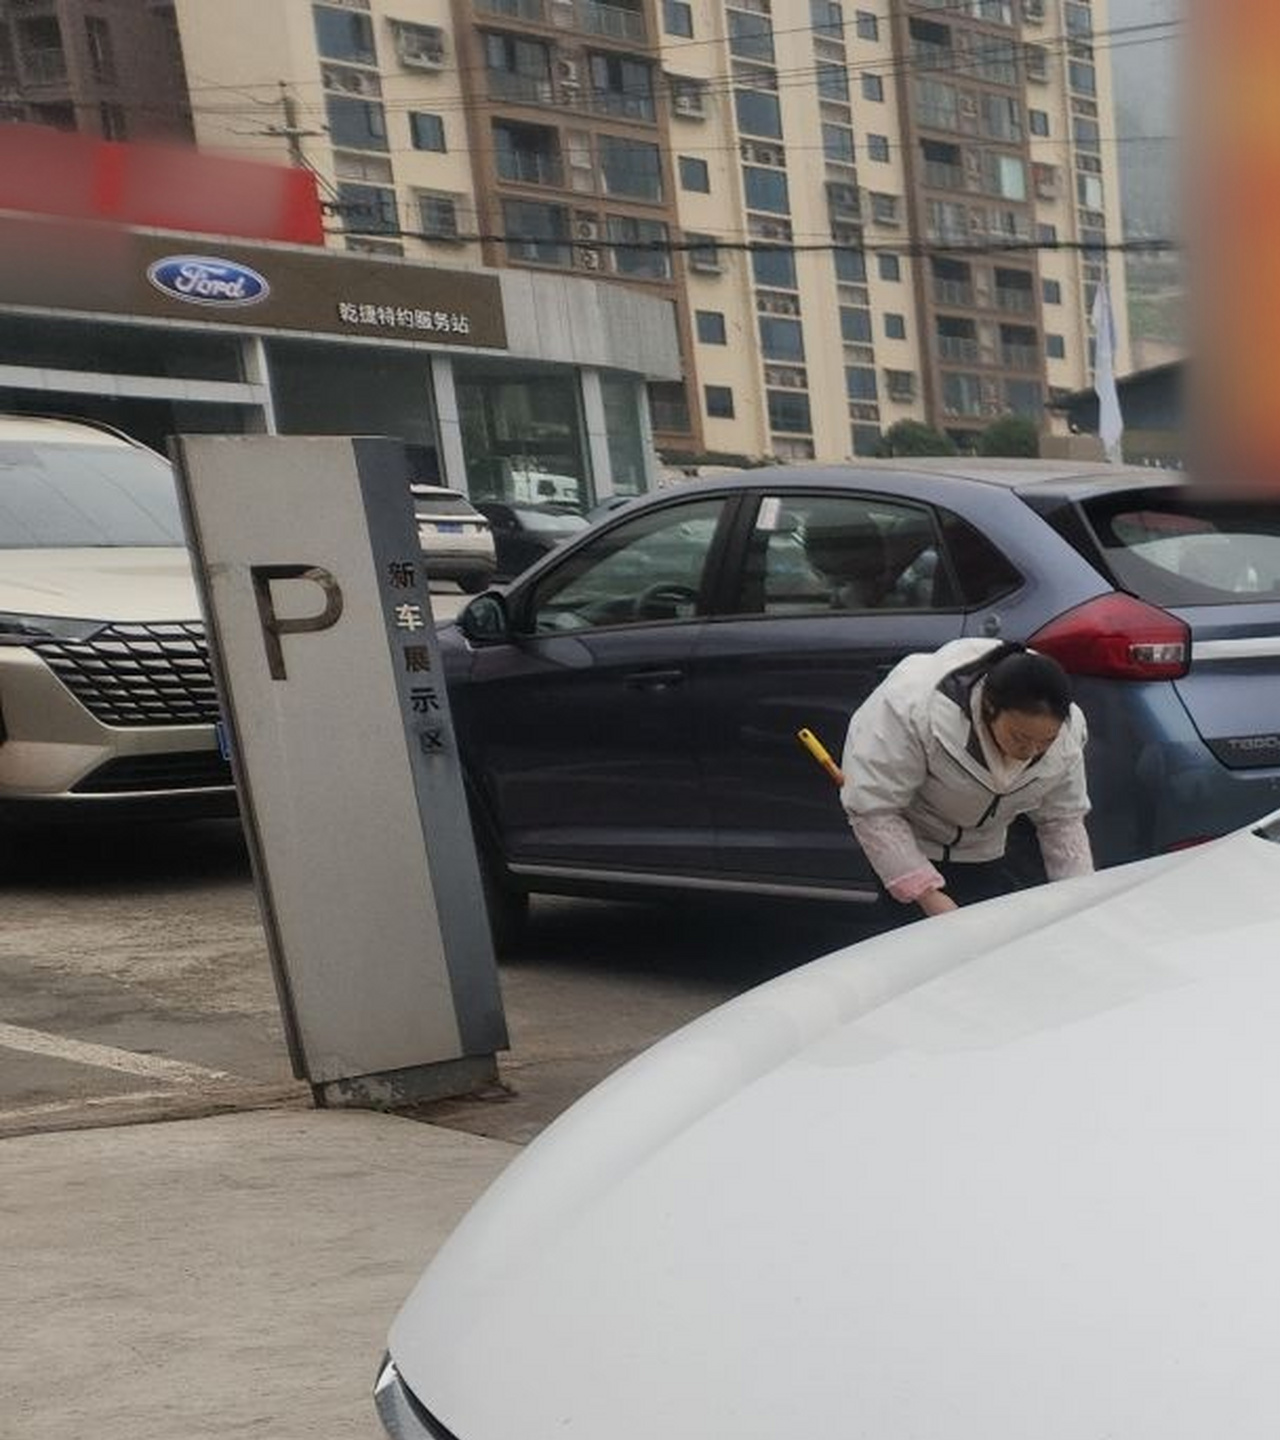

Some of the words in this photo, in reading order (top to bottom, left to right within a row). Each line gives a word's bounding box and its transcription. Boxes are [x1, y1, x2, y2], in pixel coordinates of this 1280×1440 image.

[174, 262, 246, 298] Ford
[338, 301, 470, 335] 乾捷特约服务站
[250, 563, 344, 680] P
